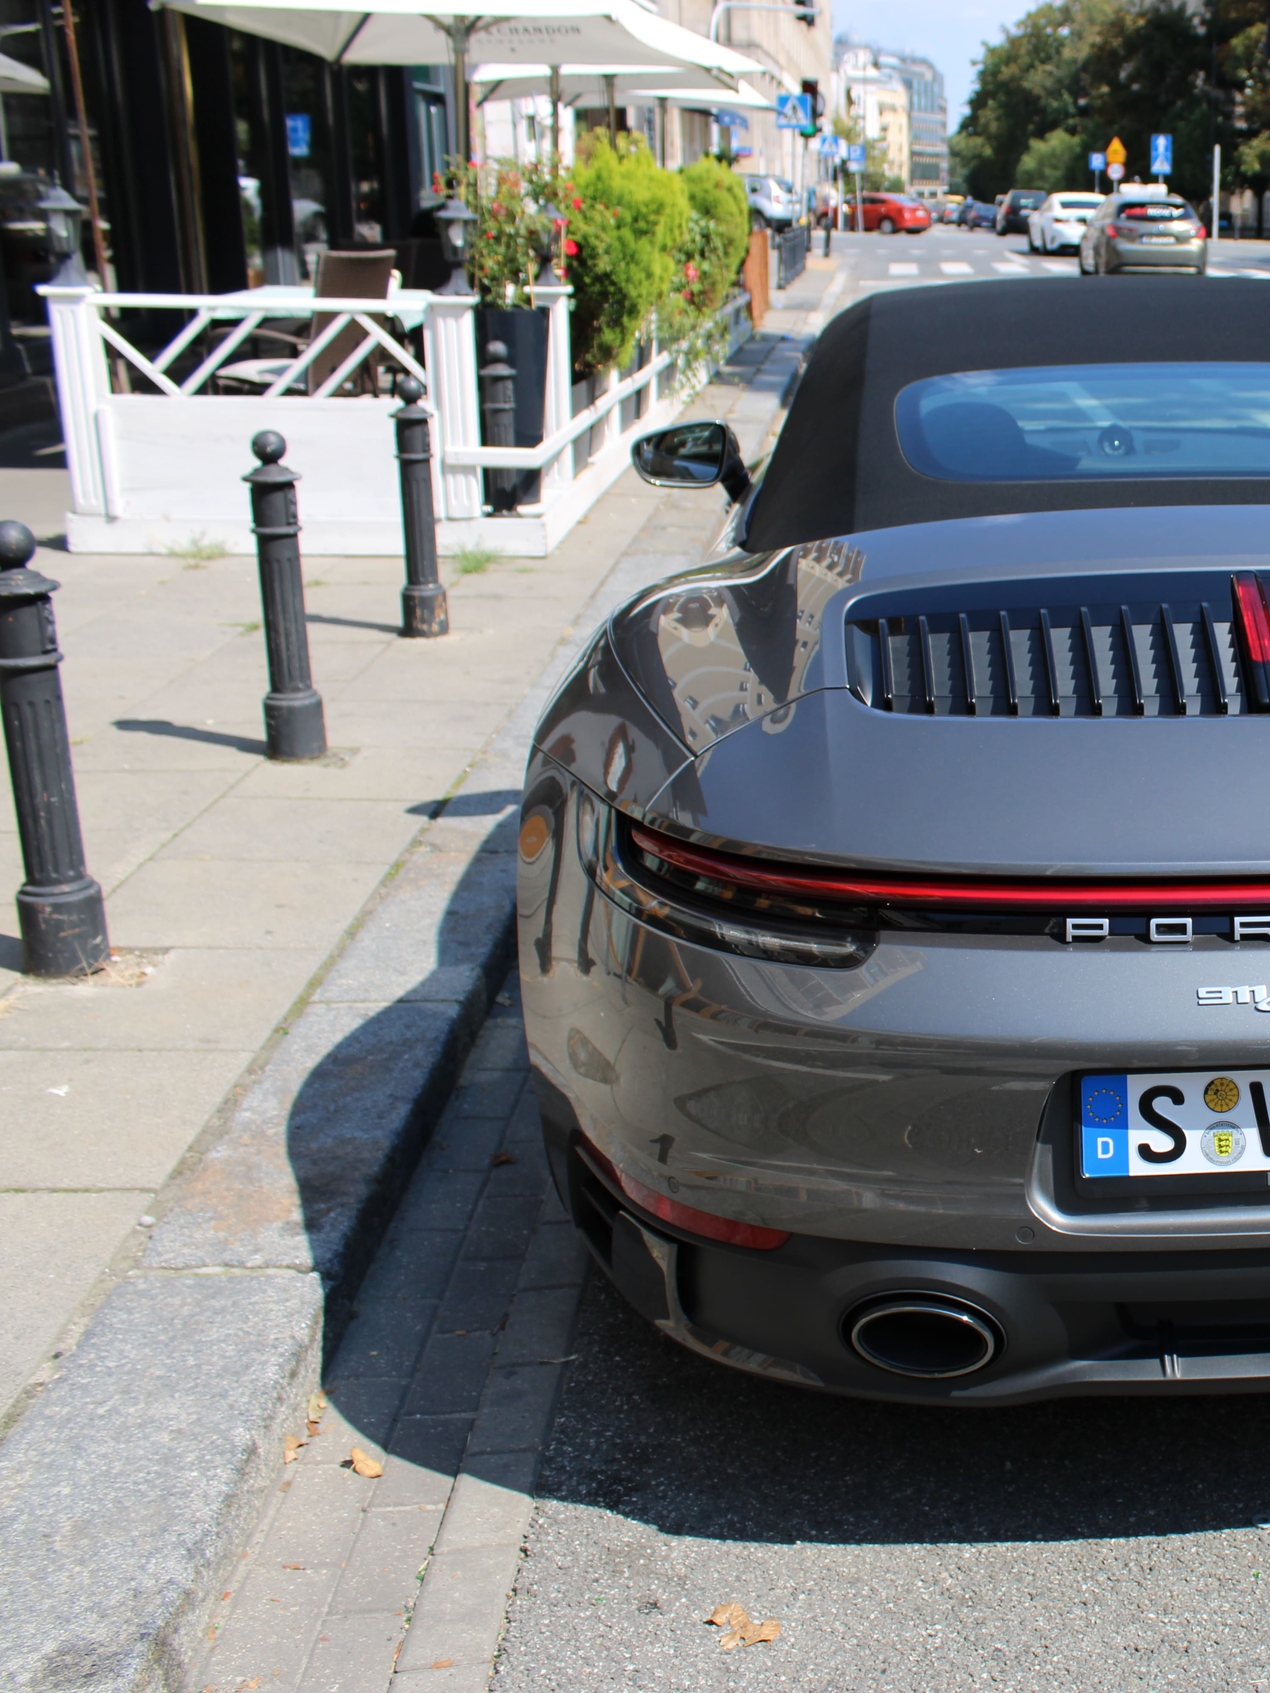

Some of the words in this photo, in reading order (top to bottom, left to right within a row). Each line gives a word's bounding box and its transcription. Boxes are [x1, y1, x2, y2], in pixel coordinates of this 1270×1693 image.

[496, 24, 582, 35] CHANDON
[1197, 984, 1267, 1006] 911
[1137, 1084, 1188, 1164] S
[1097, 1137, 1114, 1160] D
